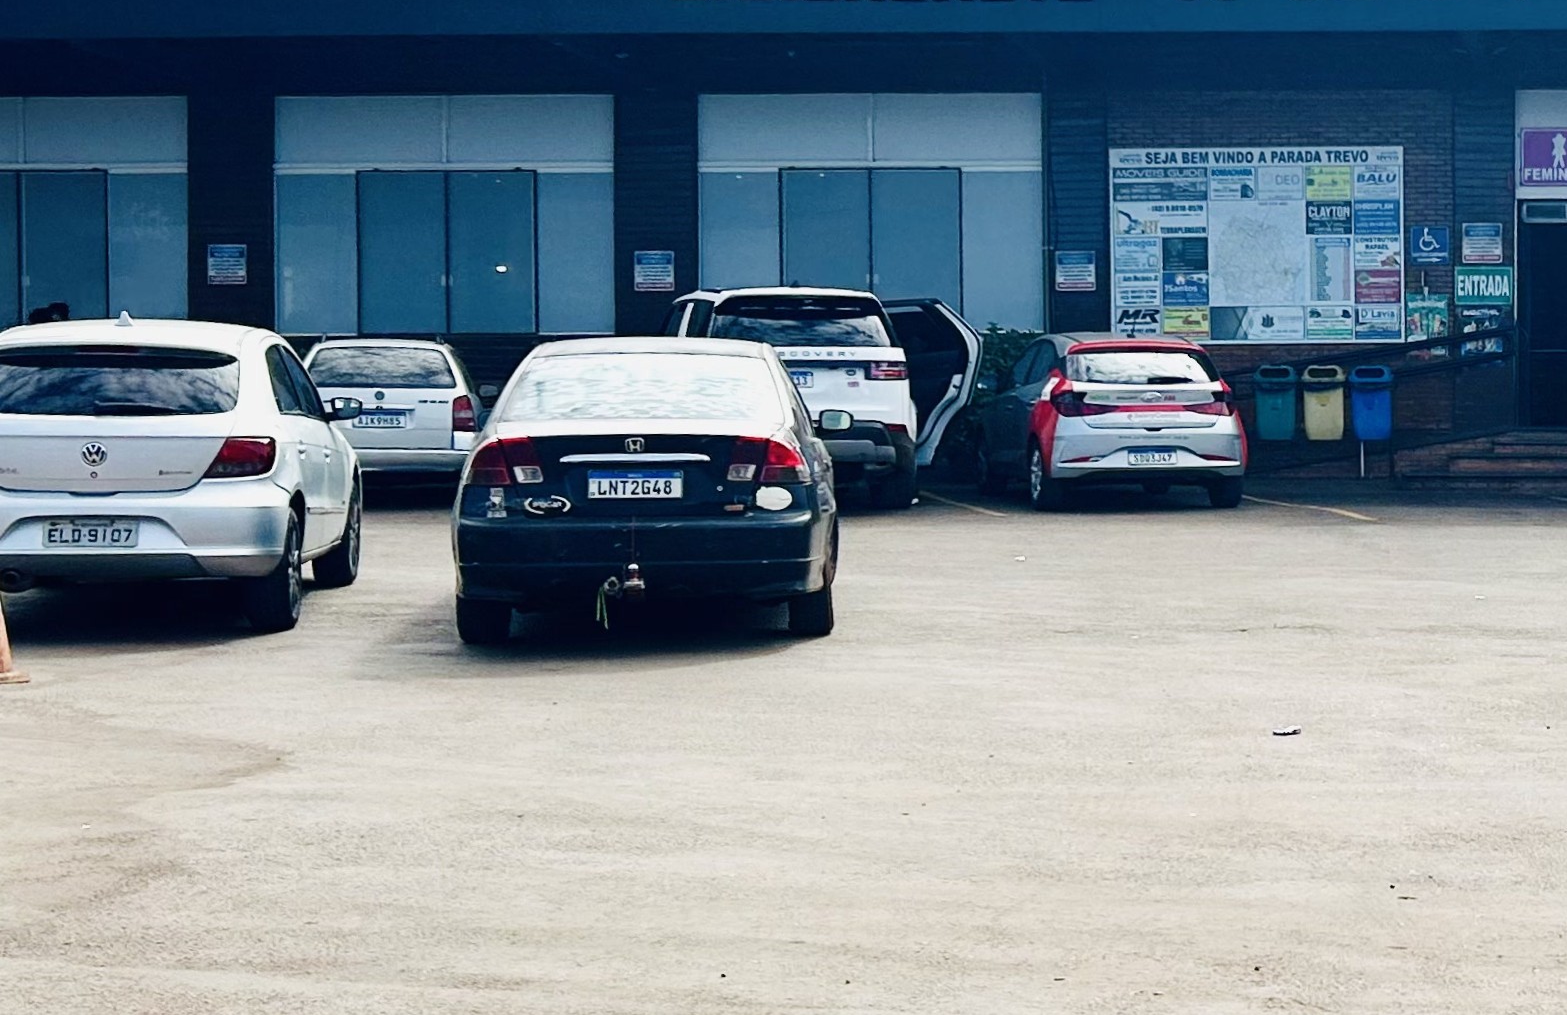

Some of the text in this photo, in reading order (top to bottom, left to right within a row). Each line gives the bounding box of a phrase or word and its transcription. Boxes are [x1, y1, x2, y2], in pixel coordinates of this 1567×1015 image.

[1145, 150, 1369, 164] SEJA BEM VINDO A PARADA TREVO
[1356, 173, 1397, 183] BALU
[1308, 206, 1351, 218] CLAYTON
[1457, 274, 1510, 297] ENTRADA
[1117, 309, 1160, 324] MR
[597, 480, 673, 495] LNT2G48
